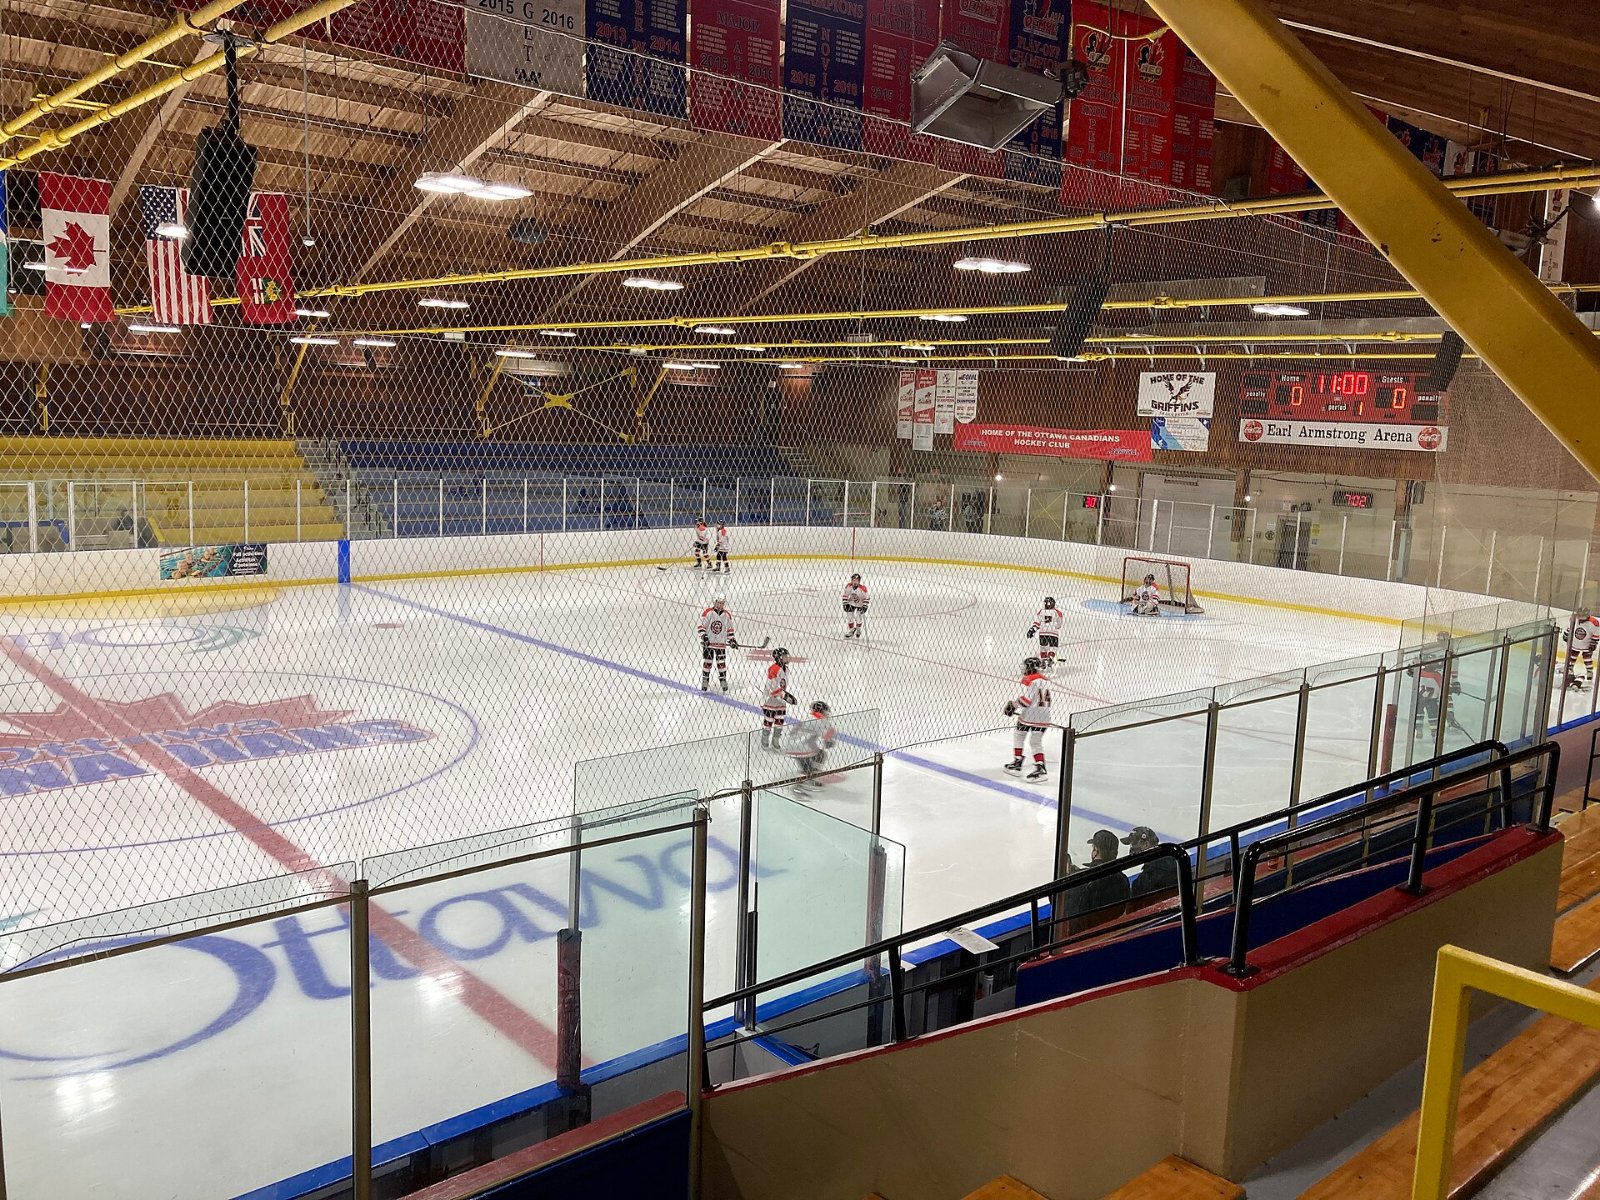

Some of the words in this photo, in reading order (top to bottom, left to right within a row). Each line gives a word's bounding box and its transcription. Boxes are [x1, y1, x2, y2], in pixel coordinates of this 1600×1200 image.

[479, 0, 514, 14] 2015
[541, 9, 574, 30] 2016
[716, 10, 760, 33] MAJOR
[595, 21, 627, 43] 2013
[649, 35, 681, 56] 2014
[700, 53, 729, 72] 2015
[748, 63, 775, 82] 2016
[789, 69, 817, 88] 2015
[1150, 373, 1175, 385] HOME
[1175, 373, 1188, 382] OF
[1188, 374, 1205, 385] THE
[1318, 373, 1369, 395] 11:00
[1291, 386, 1303, 406] 0
[1393, 388, 1406, 409] 0
[1151, 399, 1200, 413] GRIFFINS
[1328, 403, 1347, 411] period
[981, 428, 1004, 437] HOME
[1005, 430, 1016, 438] OF
[1017, 430, 1033, 438] THE
[1034, 431, 1068, 441] OTTAWA
[1069, 433, 1120, 443] CANADIANS
[1014, 438, 1047, 447] HOCKEY
[1048, 440, 1070, 449] CLUB
[1267, 424, 1292, 437] Earl
[1298, 425, 1367, 444] Armstrong
[1373, 428, 1413, 442] Arena
[1345, 494, 1367, 508] 7:02
